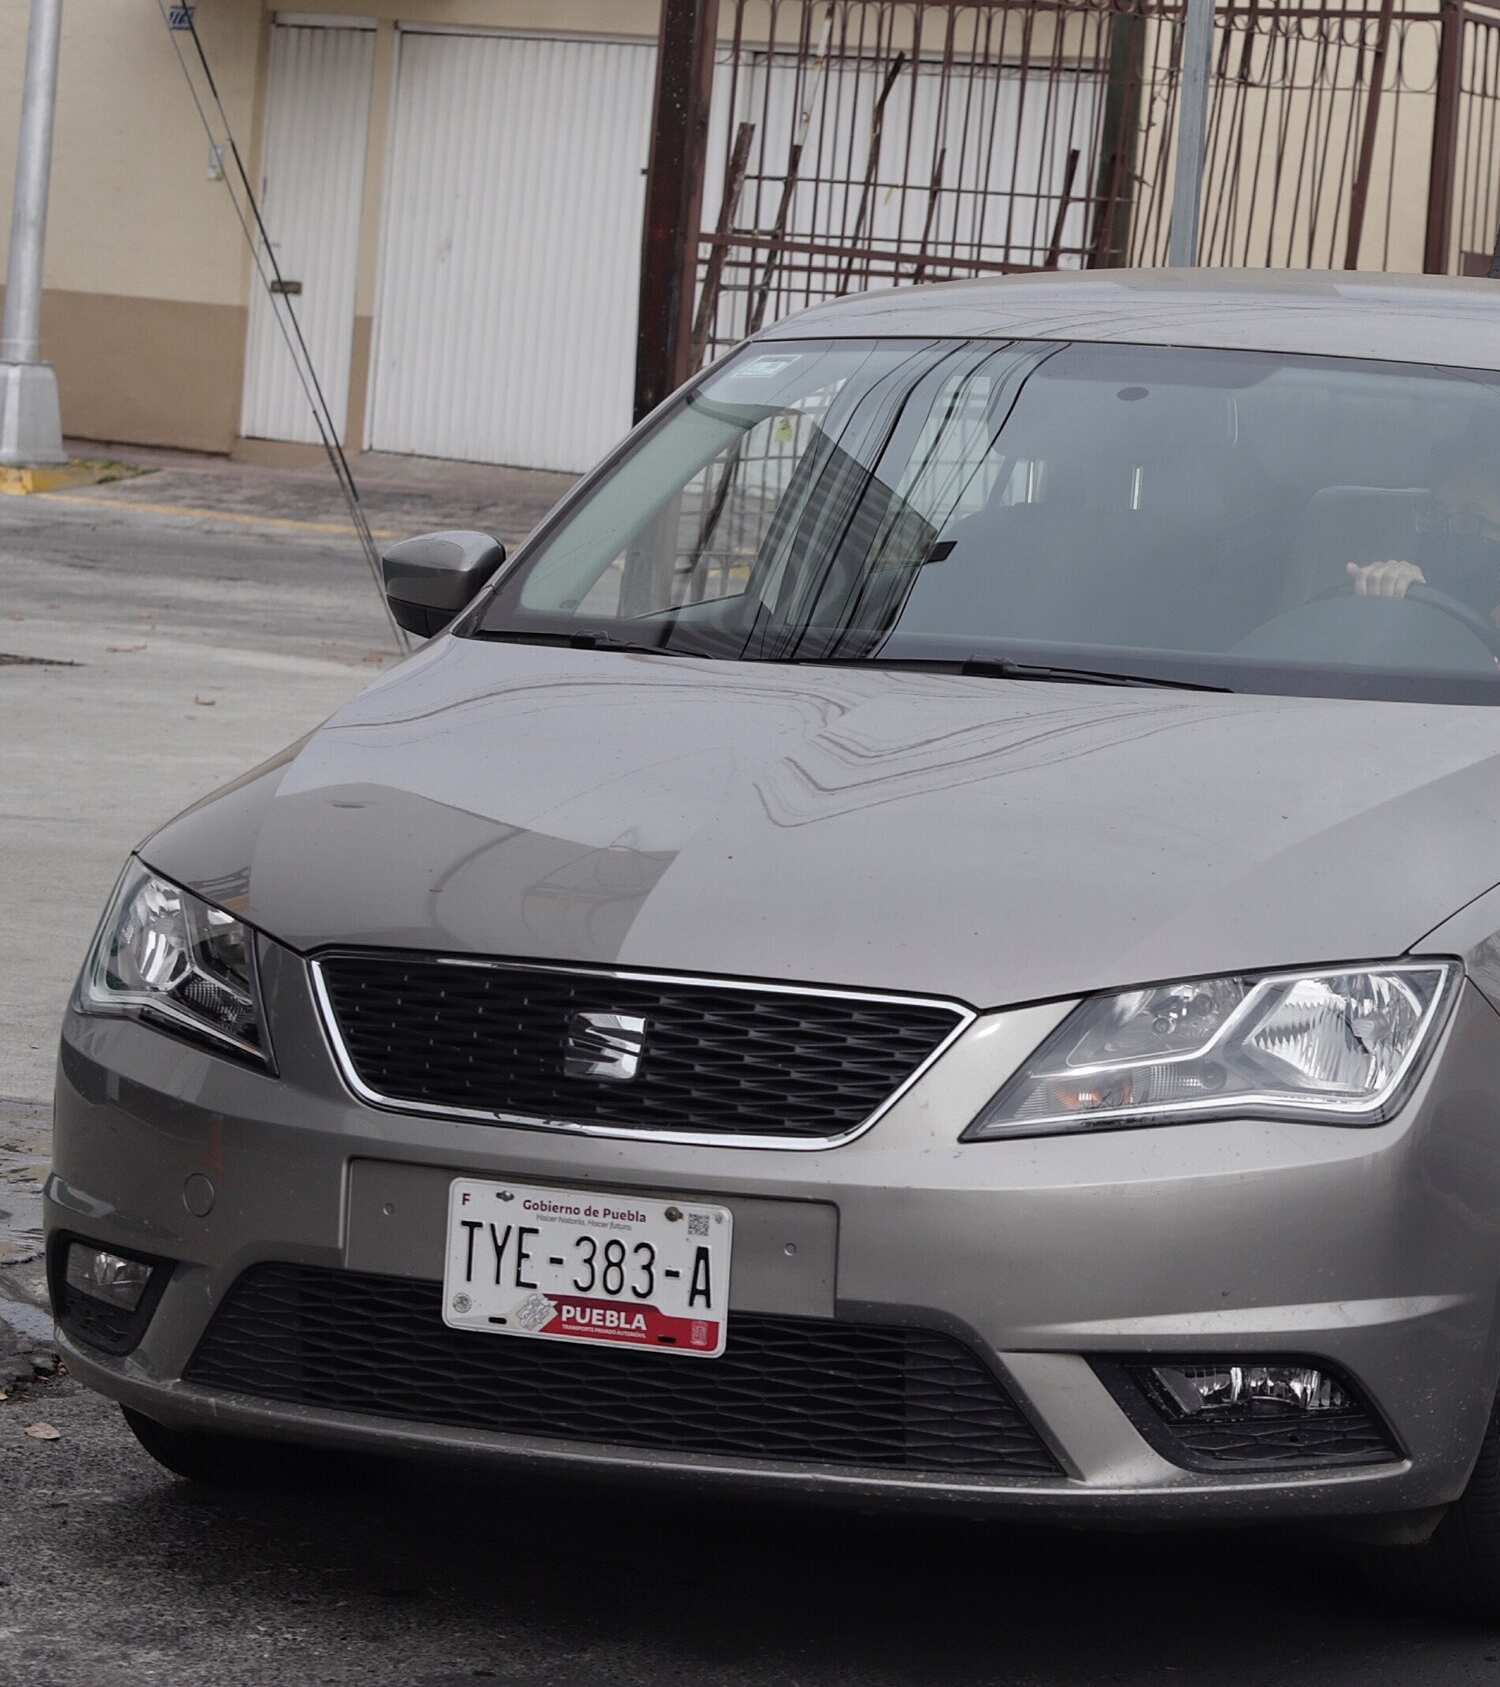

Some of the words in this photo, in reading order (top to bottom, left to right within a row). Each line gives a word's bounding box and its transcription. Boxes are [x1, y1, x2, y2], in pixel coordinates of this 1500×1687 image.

[462, 1193, 471, 1206] F
[523, 1200, 581, 1216] Gobierno
[584, 1206, 600, 1218] de
[603, 1208, 647, 1223] Puebla
[461, 1220, 711, 1308] TYE-383-A
[561, 1305, 648, 1331] PUEBLA
